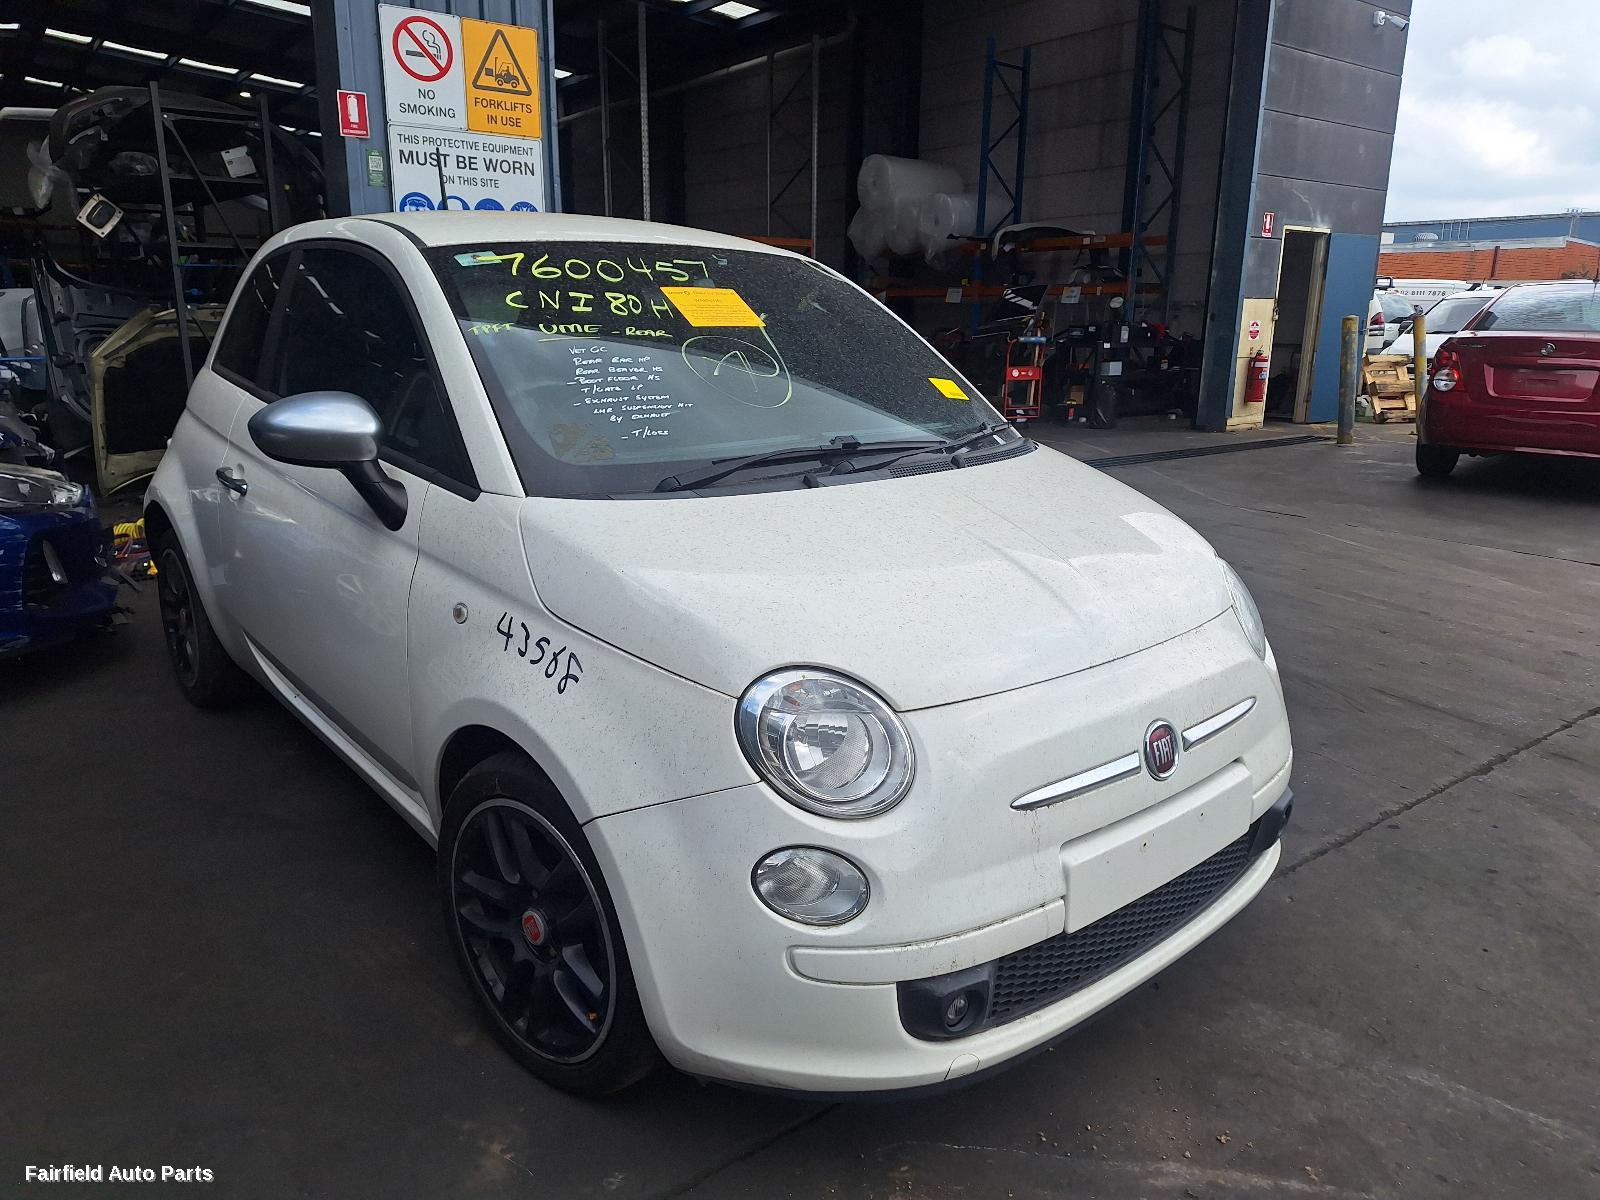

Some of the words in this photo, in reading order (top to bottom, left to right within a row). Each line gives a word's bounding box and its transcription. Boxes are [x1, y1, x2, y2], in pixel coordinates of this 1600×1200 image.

[418, 88, 436, 100] NO
[399, 102, 457, 119] SMOKING
[474, 97, 533, 114] FORKLIFTS
[487, 114, 498, 125] IN
[501, 116, 522, 128] USE
[397, 133, 420, 145] THIS
[422, 137, 480, 151] PROTECTIVE
[483, 142, 534, 157] EQUIPMENT
[399, 149, 450, 168] MUST
[456, 155, 479, 171] BE
[483, 157, 535, 177] WORN
[457, 176, 478, 187] THIS
[480, 178, 500, 189] SITE
[475, 252, 709, 283] 7600457
[1152, 735, 1174, 767] FIAT
